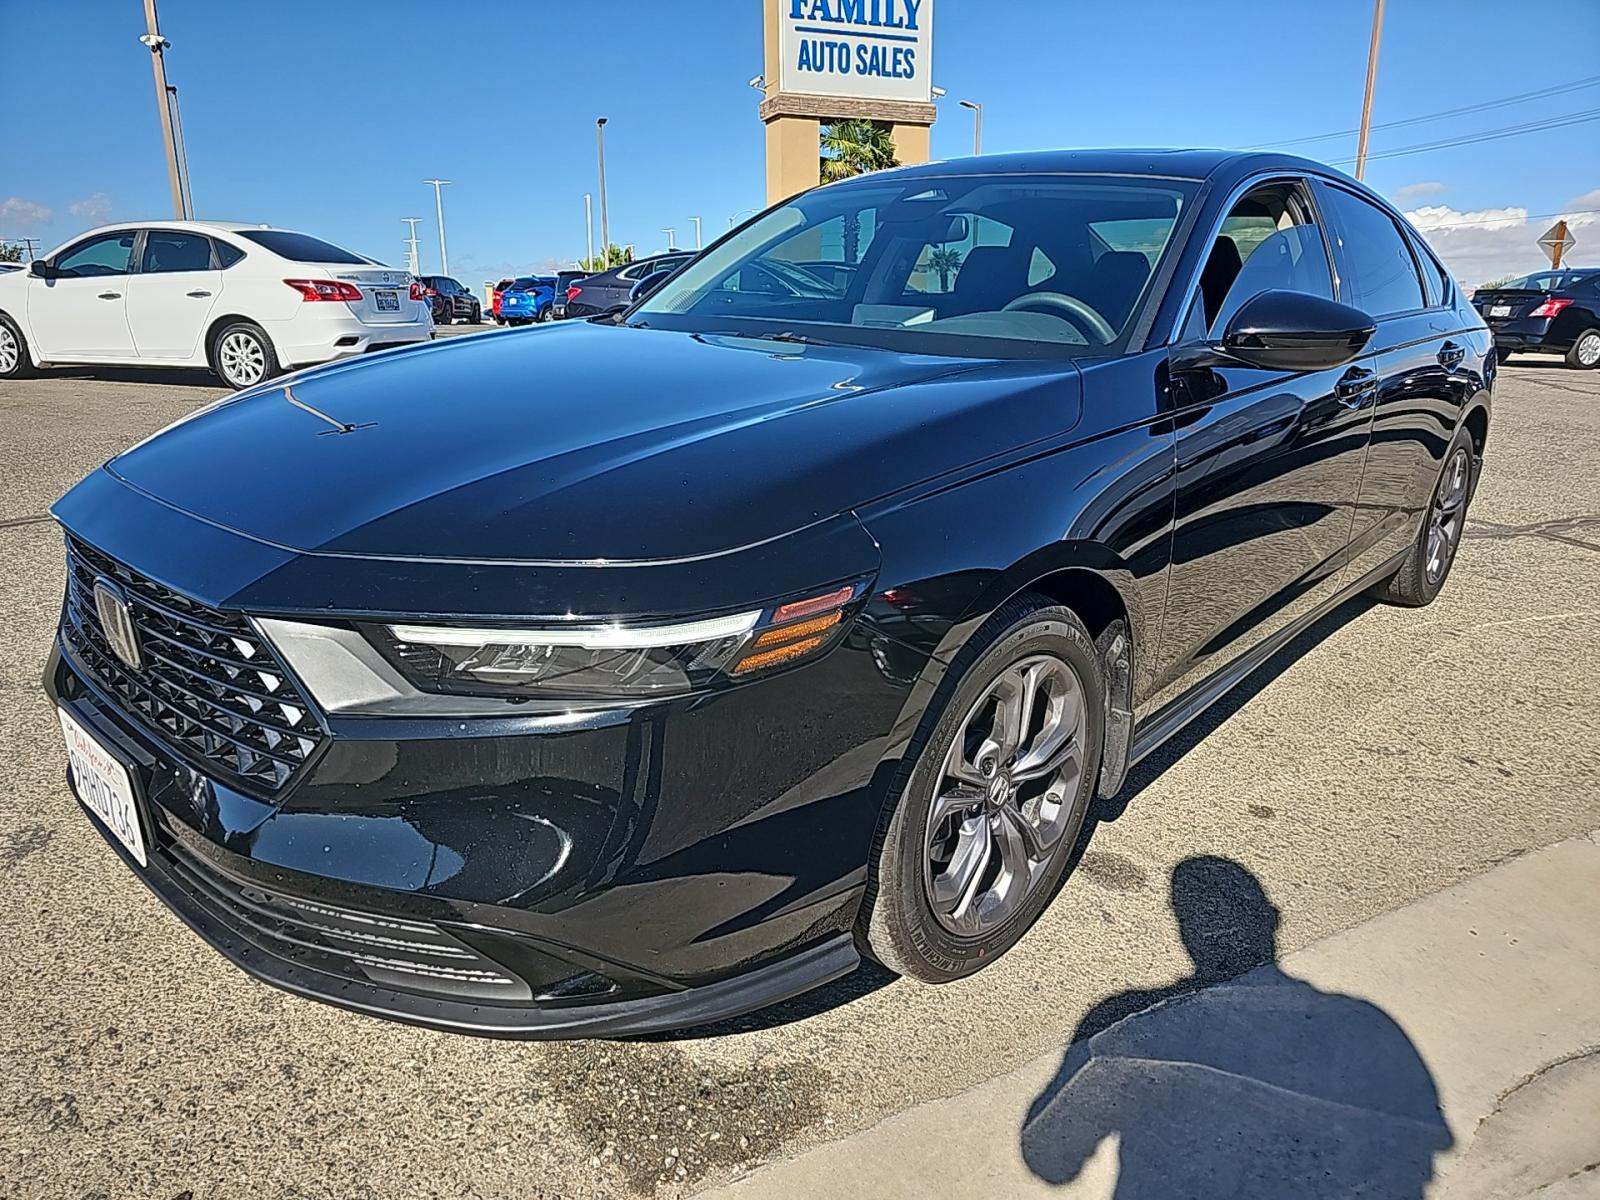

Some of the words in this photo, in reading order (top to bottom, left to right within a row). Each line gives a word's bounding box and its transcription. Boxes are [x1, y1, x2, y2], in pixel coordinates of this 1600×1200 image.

[789, 0, 919, 30] FAMILY
[797, 39, 851, 74] AUTO
[855, 43, 915, 79] SALES
[70, 749, 136, 847] 9HHD736
